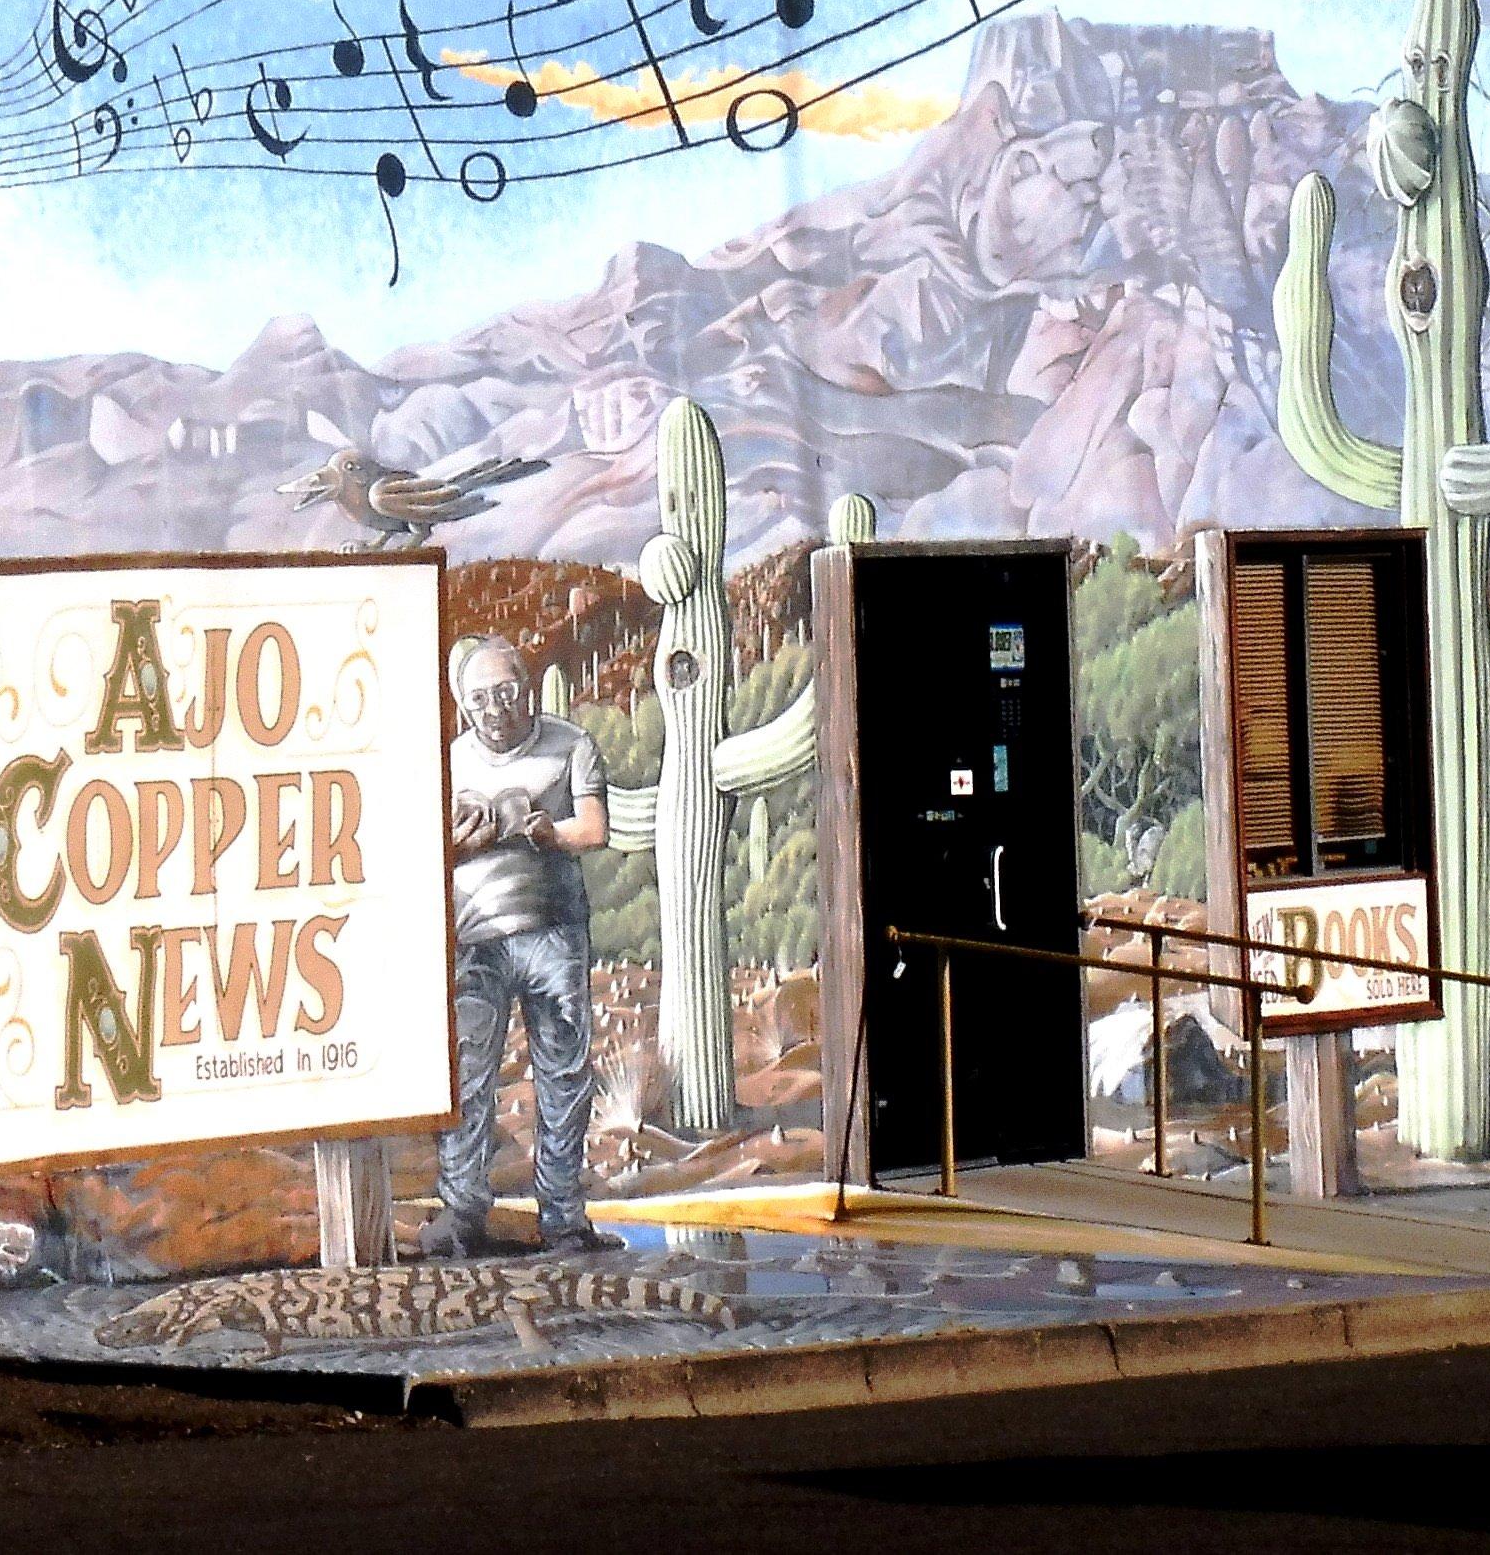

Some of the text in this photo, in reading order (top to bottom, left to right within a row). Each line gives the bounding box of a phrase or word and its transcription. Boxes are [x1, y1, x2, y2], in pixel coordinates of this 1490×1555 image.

[84, 598, 302, 753] AJO
[1276, 902, 1418, 1004] BOOKS
[1367, 974, 1423, 1000] SOLD HERE
[55, 914, 350, 1110] NEWS
[196, 1048, 284, 1080] Established
[322, 1041, 358, 1071] 1916
